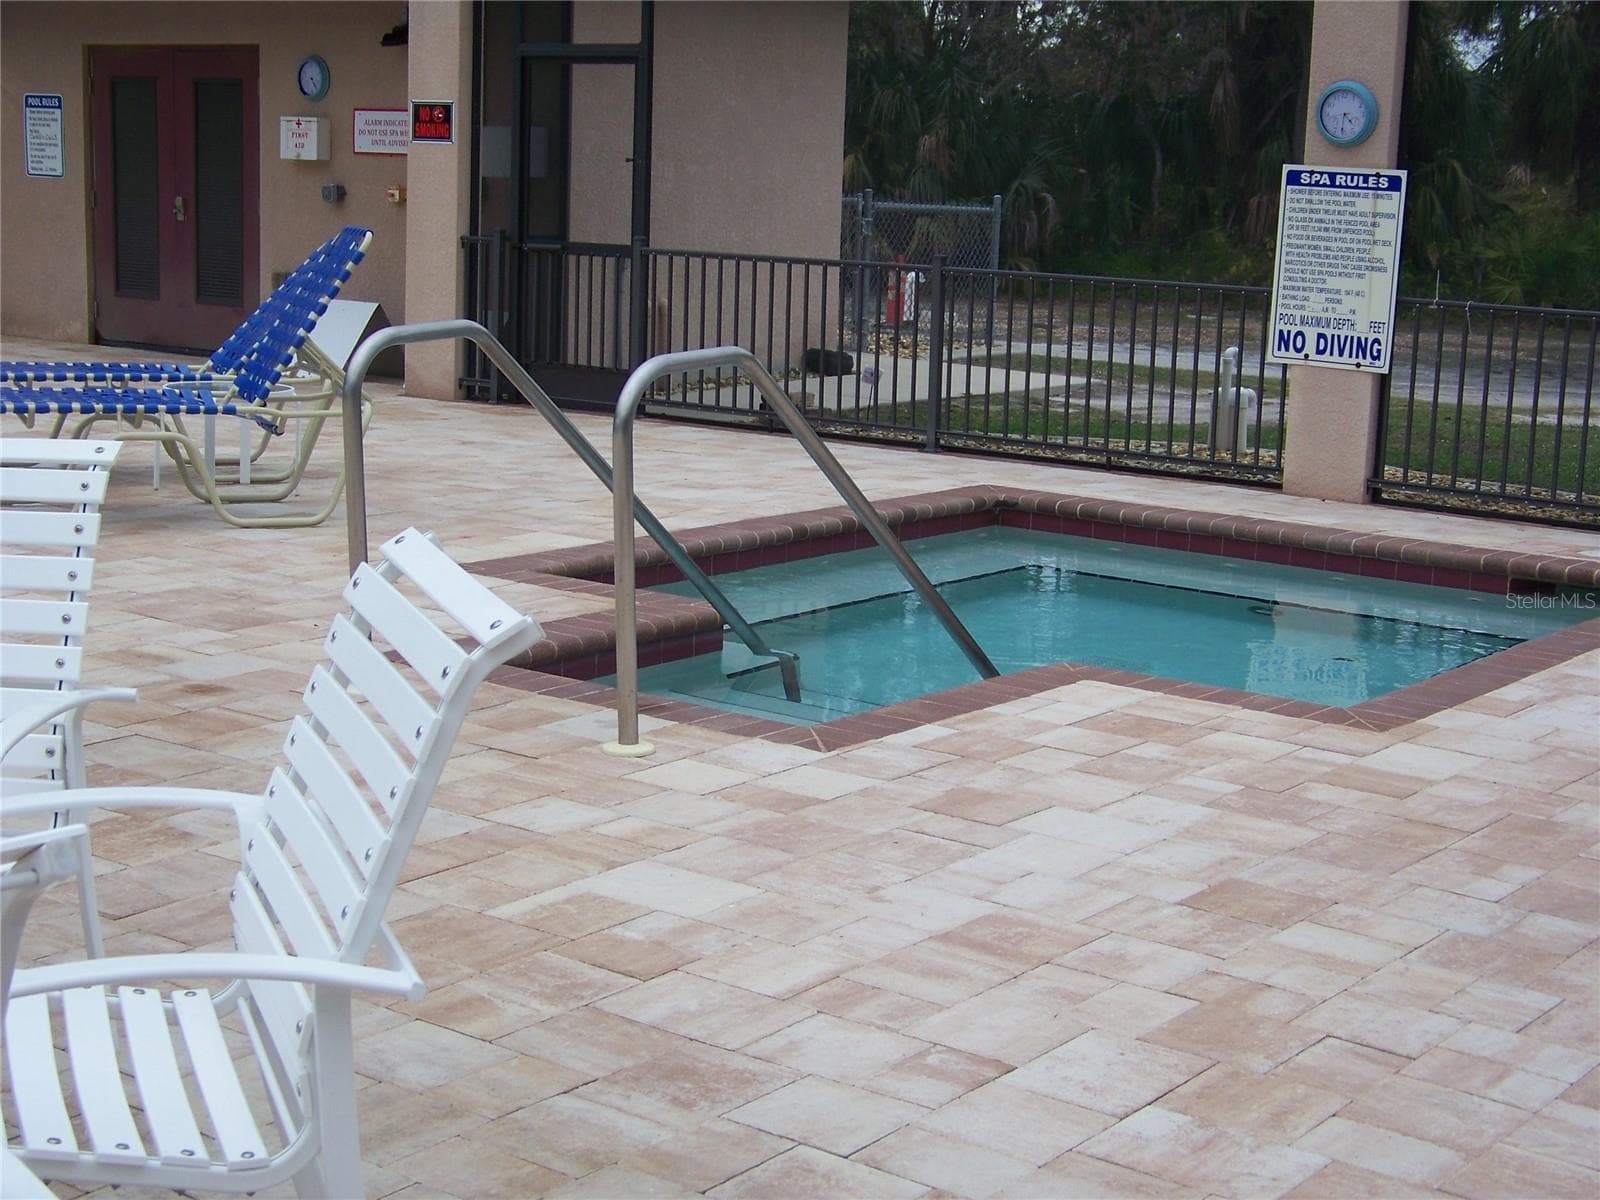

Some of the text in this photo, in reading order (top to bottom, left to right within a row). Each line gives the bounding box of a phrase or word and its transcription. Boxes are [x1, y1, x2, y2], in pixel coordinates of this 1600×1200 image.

[28, 97, 59, 107] POOL RULES
[419, 107, 430, 119] NO
[291, 131, 308, 139] FIRST
[415, 123, 449, 138] SMOKING
[1300, 172, 1389, 188] SPA RULES
[1311, 235, 1334, 243] BEVERAGES
[1285, 259, 1306, 267] NARCOTICS
[1279, 313, 1386, 334] POOL MAXIMUM DEPTH: FEET
[1277, 329, 1382, 361] NO DIVING
